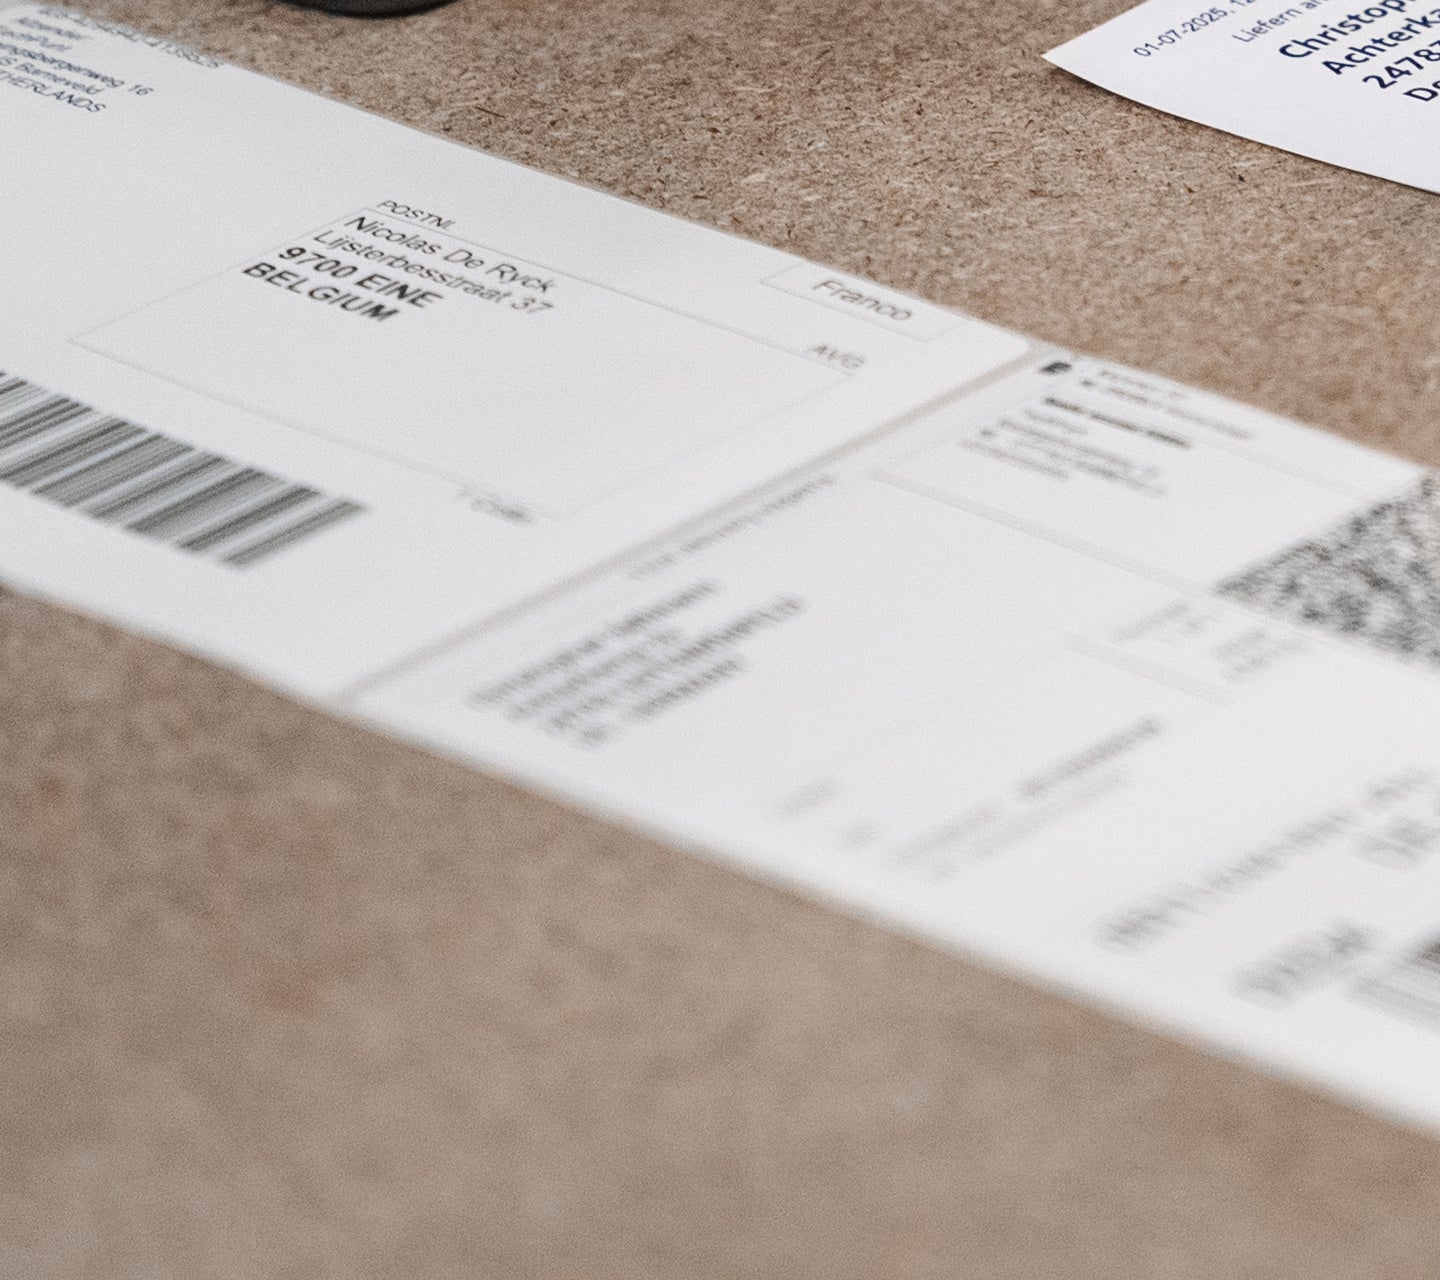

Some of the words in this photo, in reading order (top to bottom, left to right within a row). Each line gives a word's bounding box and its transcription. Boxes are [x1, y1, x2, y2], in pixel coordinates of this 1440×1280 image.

[1132, 7, 1228, 57] 01-07-2025,
[1231, 8, 1302, 42] Liefern
[127, 83, 154, 96] 16
[277, 246, 358, 278] 9700
[354, 273, 441, 307] EINE
[312, 229, 512, 302] Lijsterbesstraat
[509, 296, 554, 313] 37
[344, 215, 441, 254] Nicolas
[442, 248, 485, 268] De
[485, 262, 552, 293] Ryck
[242, 261, 399, 320] BELGIUM
[812, 278, 912, 320] Franco
